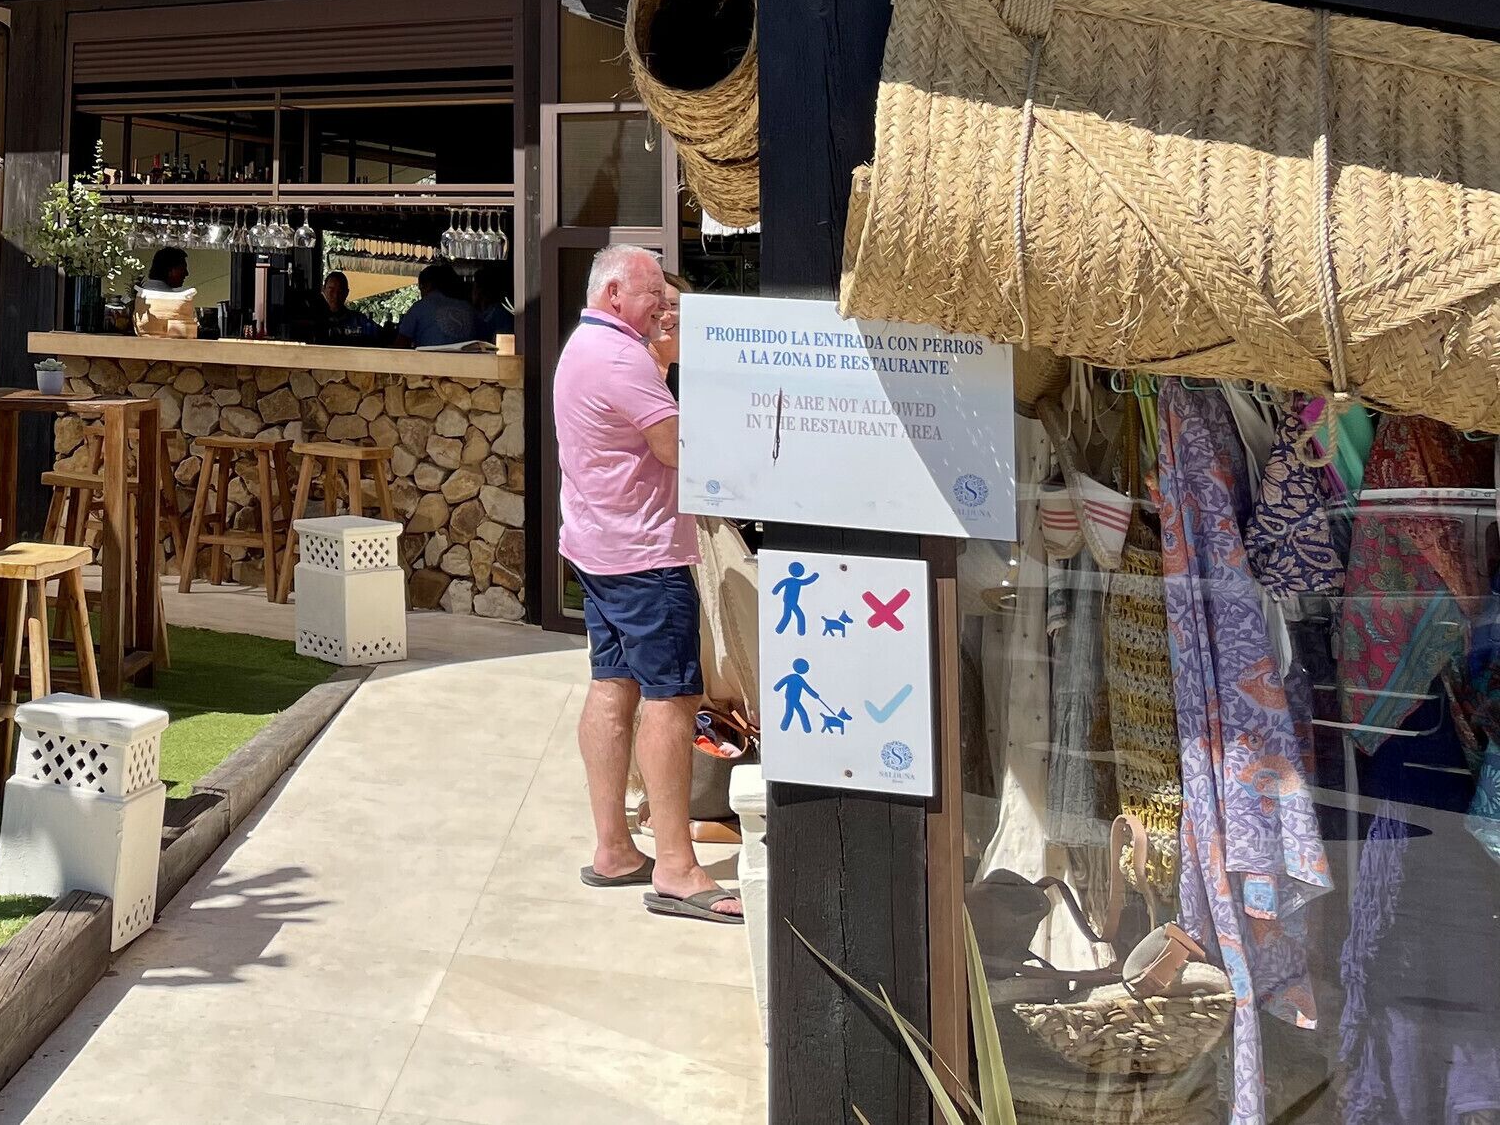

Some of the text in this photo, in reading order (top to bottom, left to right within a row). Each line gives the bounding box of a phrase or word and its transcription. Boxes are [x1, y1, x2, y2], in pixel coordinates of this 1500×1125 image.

[705, 326, 984, 355] PROHIBIDO LA ENTRADA CON PERROS
[737, 349, 950, 375] A LA ZONA DE RESTAURANTE
[794, 395, 824, 410] ARE
[828, 397, 858, 413] NOT
[862, 399, 936, 418] ALLOWED
[746, 413, 763, 428] IN
[800, 417, 898, 438] RESTAURANT
[900, 423, 943, 441] AREA
[953, 507, 992, 519] ALDUNA
